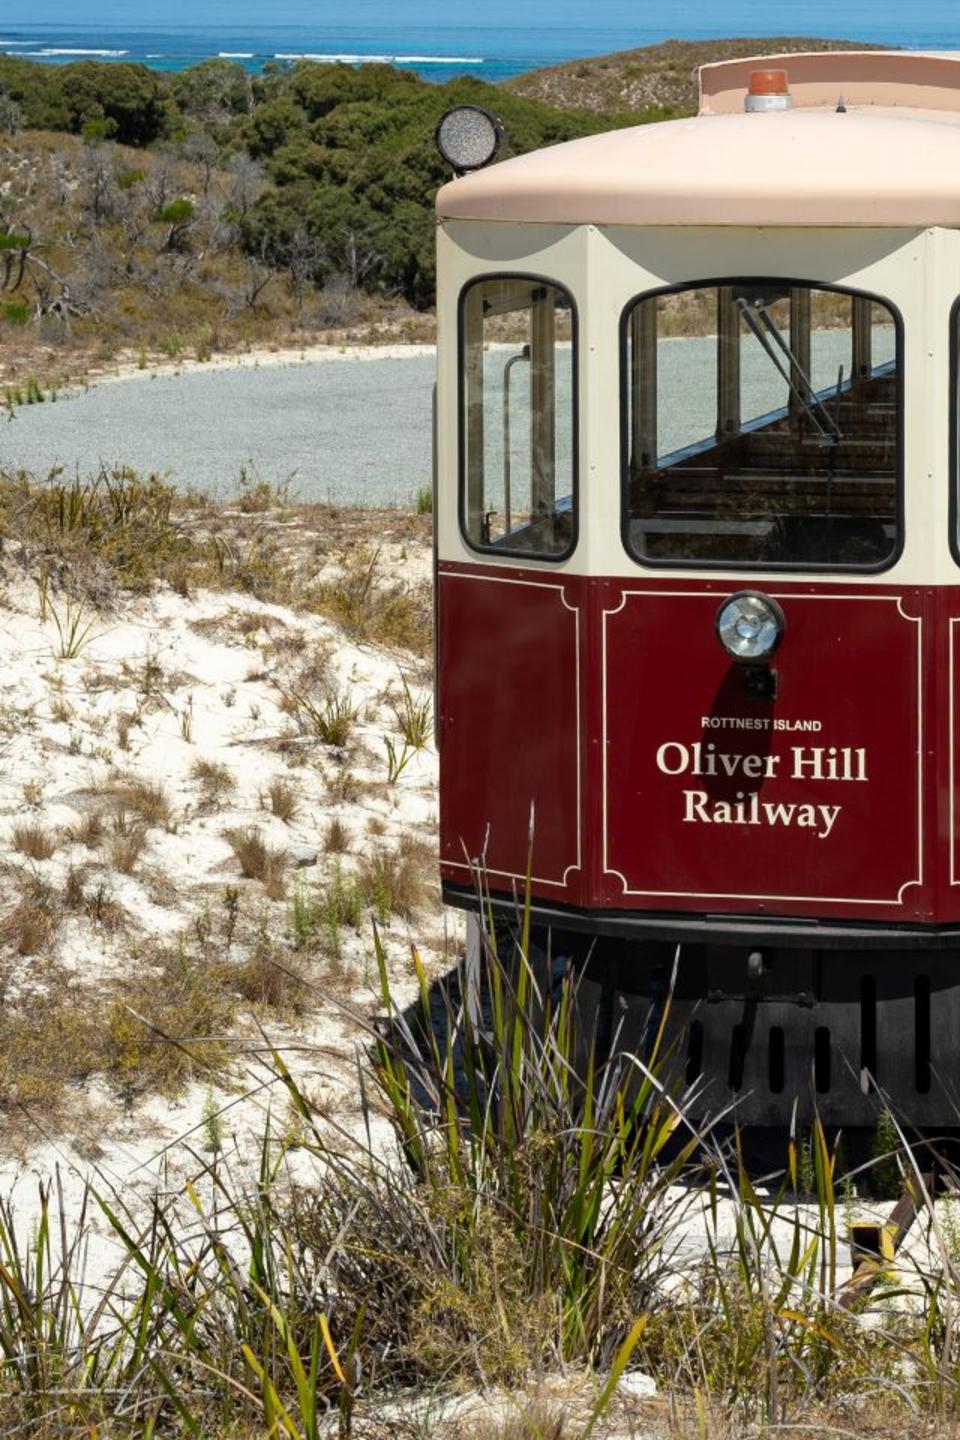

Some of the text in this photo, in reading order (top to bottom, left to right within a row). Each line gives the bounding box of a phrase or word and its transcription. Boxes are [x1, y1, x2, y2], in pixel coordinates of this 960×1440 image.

[701, 716, 822, 732] ROTTNEST ISLAND
[656, 741, 869, 781] Oliver Hill
[681, 789, 842, 839] Railway
